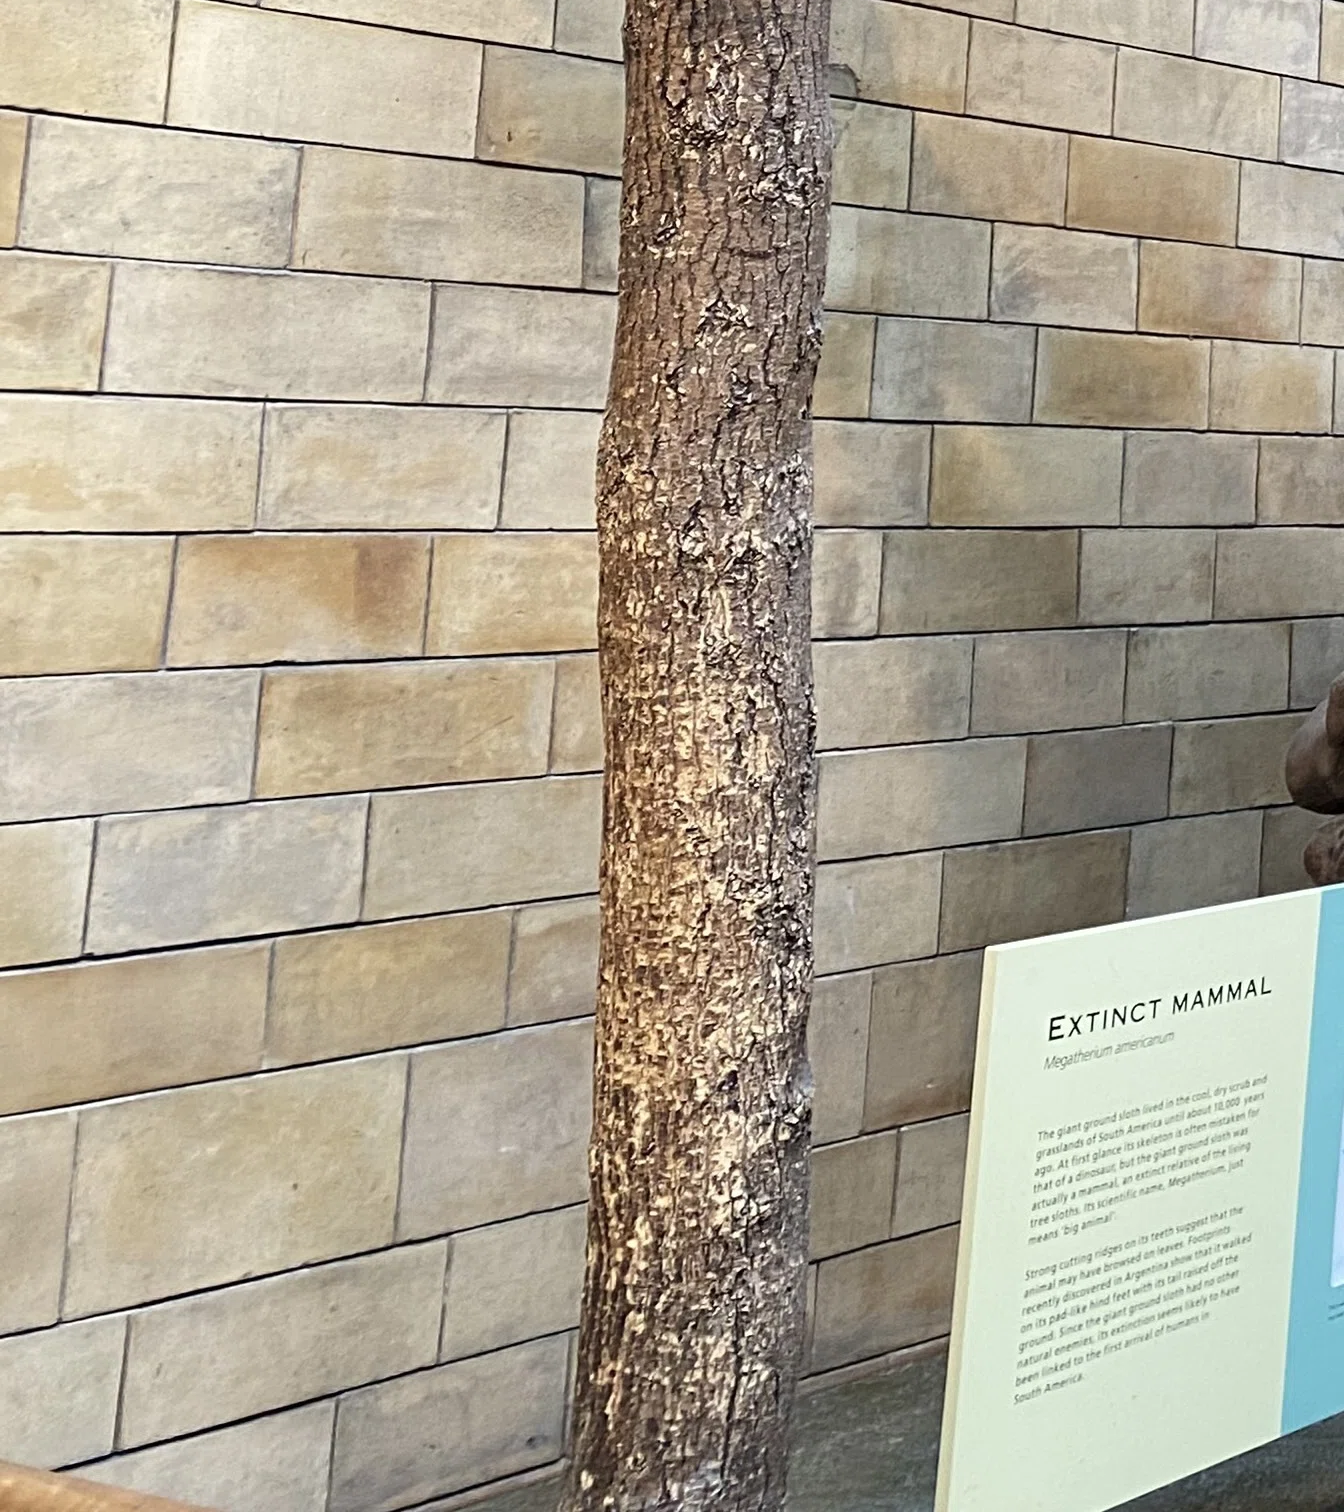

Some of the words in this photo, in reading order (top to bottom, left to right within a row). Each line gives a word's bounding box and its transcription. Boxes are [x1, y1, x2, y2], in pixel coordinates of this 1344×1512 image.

[1047, 998, 1163, 1041] EXTINCT
[1171, 976, 1274, 1015] MAMMAL
[1043, 1044, 1114, 1072] Megatherium
[1114, 1031, 1176, 1056] americanum
[1035, 1138, 1084, 1162] grasslands
[1085, 1134, 1096, 1146] of
[1097, 1126, 1125, 1143] South
[1126, 1119, 1162, 1135] America
[1163, 1111, 1185, 1125] until
[1186, 1105, 1212, 1120] about
[1243, 1092, 1264, 1107] years
[1037, 1129, 1054, 1141] The
[1056, 1122, 1081, 1139] giant
[1082, 1111, 1117, 1133] ground
[1118, 1106, 1141, 1121] sloth
[1141, 1100, 1164, 1115] lived
[1164, 1099, 1174, 1109] in
[1175, 1094, 1190, 1106] the
[1213, 1086, 1227, 1097] dry
[1228, 1078, 1250, 1092] scrub
[1251, 1073, 1268, 1086] and
[1032, 1180, 1053, 1194] that
[1054, 1175, 1066, 1188] of
[1118, 1157, 1135, 1170] but
[1135, 1153, 1151, 1165] the
[1152, 1146, 1176, 1163] giant
[1177, 1136, 1209, 1156] ground
[1209, 1130, 1231, 1145] sloth
[1232, 1127, 1249, 1138] was
[1034, 1165, 1054, 1178] ago.
[1056, 1159, 1069, 1171] At
[1070, 1153, 1090, 1167] first
[1091, 1146, 1122, 1164] glance
[1123, 1142, 1135, 1152] its
[1135, 1132, 1173, 1149] skeleton
[1174, 1129, 1182, 1138] is
[1183, 1123, 1207, 1136] often
[1207, 1113, 1246, 1130] mistaken
[1246, 1109, 1259, 1119] for
[1029, 1216, 1049, 1229] tree
[1051, 1206, 1080, 1223] sloths.
[1082, 1203, 1095, 1213] Its
[1096, 1190, 1137, 1209] scientific
[1227, 1159, 1244, 1174] just
[1031, 1193, 1068, 1212] actually
[1077, 1178, 1119, 1198] mammal,
[1121, 1176, 1133, 1186] an
[1134, 1165, 1166, 1182] extinct
[1165, 1157, 1200, 1173] relative
[1200, 1151, 1211, 1163] of
[1211, 1148, 1226, 1160] the
[1023, 1279, 1056, 1299] animal
[1057, 1275, 1078, 1288] may
[1078, 1267, 1102, 1281] have
[1102, 1252, 1142, 1274] browsed
[1142, 1250, 1156, 1261] on
[1186, 1226, 1231, 1247] Footprints
[1024, 1265, 1057, 1282] Strong
[1058, 1254, 1093, 1271] cutting
[1094, 1244, 1122, 1260] ridges
[1123, 1240, 1136, 1251] on
[1137, 1236, 1148, 1246] its
[1150, 1226, 1174, 1242] teeth
[1175, 1216, 1208, 1234] suggest
[1209, 1210, 1227, 1224] that
[1228, 1206, 1243, 1218] the
[1027, 1230, 1059, 1246] means
[1019, 1323, 1033, 1334] on
[1034, 1318, 1047, 1329] its
[1088, 1294, 1111, 1311] hind
[1111, 1289, 1131, 1303] feet
[1131, 1280, 1153, 1297] with
[1153, 1279, 1165, 1289] its
[1166, 1271, 1182, 1285] tail
[1182, 1262, 1209, 1280] raised
[1209, 1257, 1223, 1270] off
[1224, 1253, 1239, 1266] the
[1021, 1296, 1060, 1317] recently
[1061, 1277, 1112, 1303] discovered
[1112, 1276, 1122, 1287] in
[1123, 1262, 1169, 1283] Argentina
[1169, 1254, 1193, 1268] show
[1193, 1246, 1213, 1260] that
[1212, 1243, 1221, 1254] it
[1221, 1232, 1252, 1251] walked
[1058, 1323, 1083, 1338] Since
[1084, 1316, 1101, 1329] the
[1102, 1307, 1127, 1326] giant
[1127, 1294, 1162, 1317] ground
[1161, 1286, 1184, 1303] sloth
[1184, 1280, 1203, 1295] had
[1202, 1278, 1216, 1289] no
[1215, 1270, 1239, 1285] other
[1014, 1371, 1040, 1387] been
[1040, 1357, 1072, 1378] linked
[1072, 1356, 1084, 1367] to
[1085, 1349, 1101, 1362] the
[1102, 1341, 1122, 1356] first
[1123, 1329, 1153, 1348] arrival
[1154, 1325, 1164, 1338] of
[1200, 1311, 1210, 1321] in
[1016, 1347, 1052, 1370] natural
[1096, 1331, 1109, 1342] its
[1156, 1305, 1184, 1321] seems
[1183, 1296, 1207, 1311] likely
[1208, 1293, 1218, 1303] to
[1219, 1285, 1240, 1299] have
[1013, 1384, 1042, 1404] South
